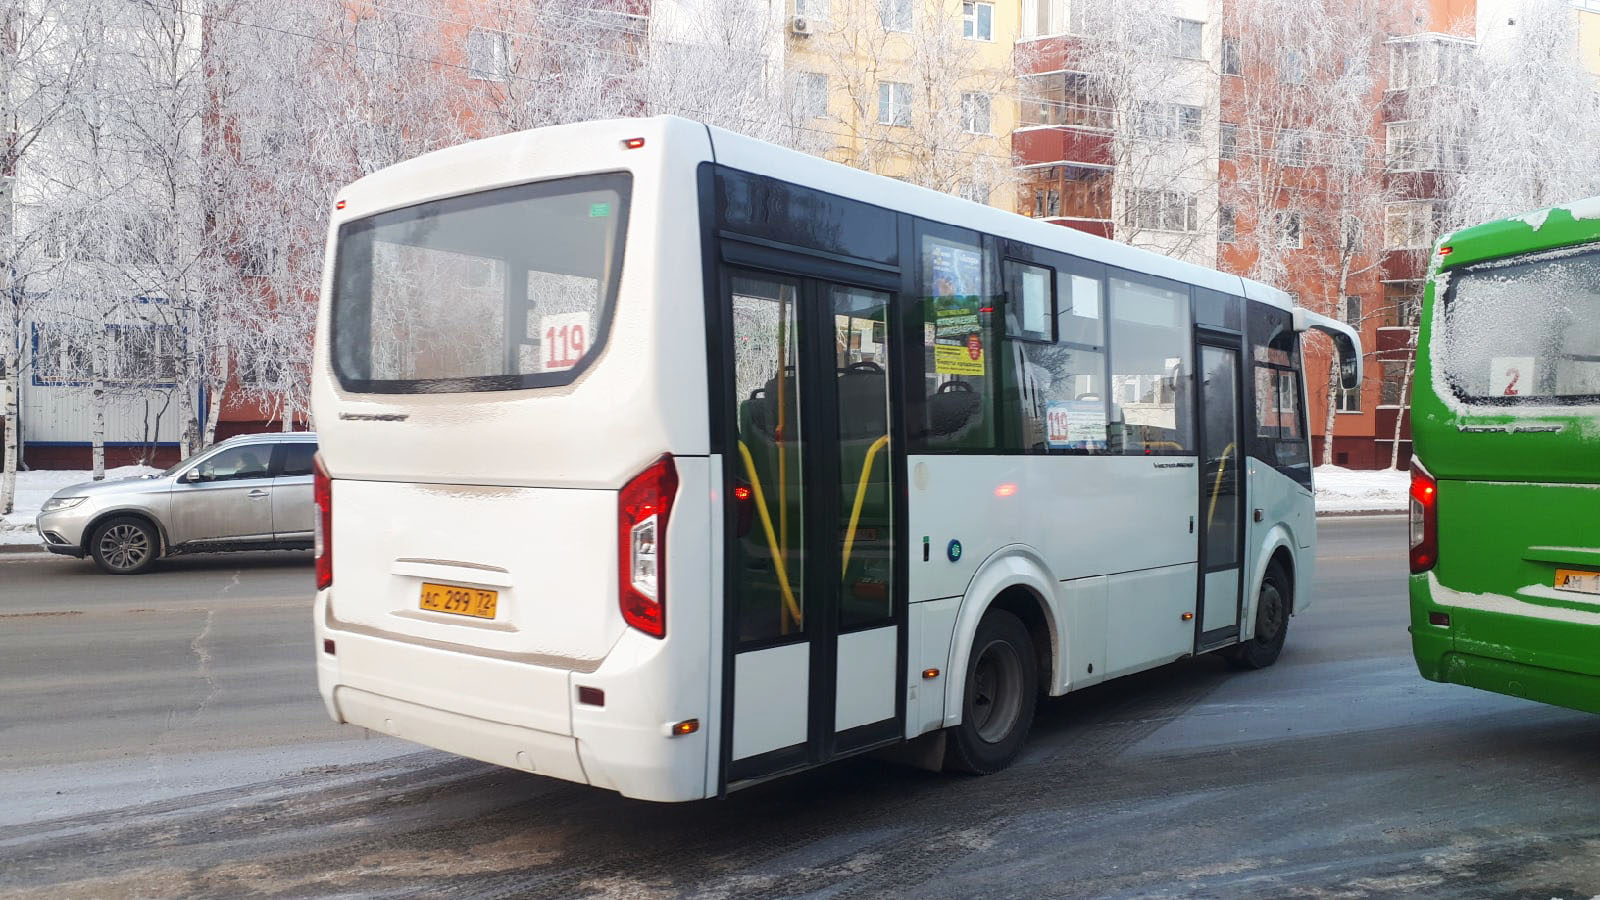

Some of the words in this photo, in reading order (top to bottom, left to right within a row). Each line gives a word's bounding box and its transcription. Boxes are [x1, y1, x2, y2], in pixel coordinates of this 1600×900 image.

[546, 325, 585, 368] 119
[1504, 368, 1520, 395] 2
[1048, 411, 1068, 440] 119
[445, 590, 471, 611] 299
[477, 592, 491, 610] 72
